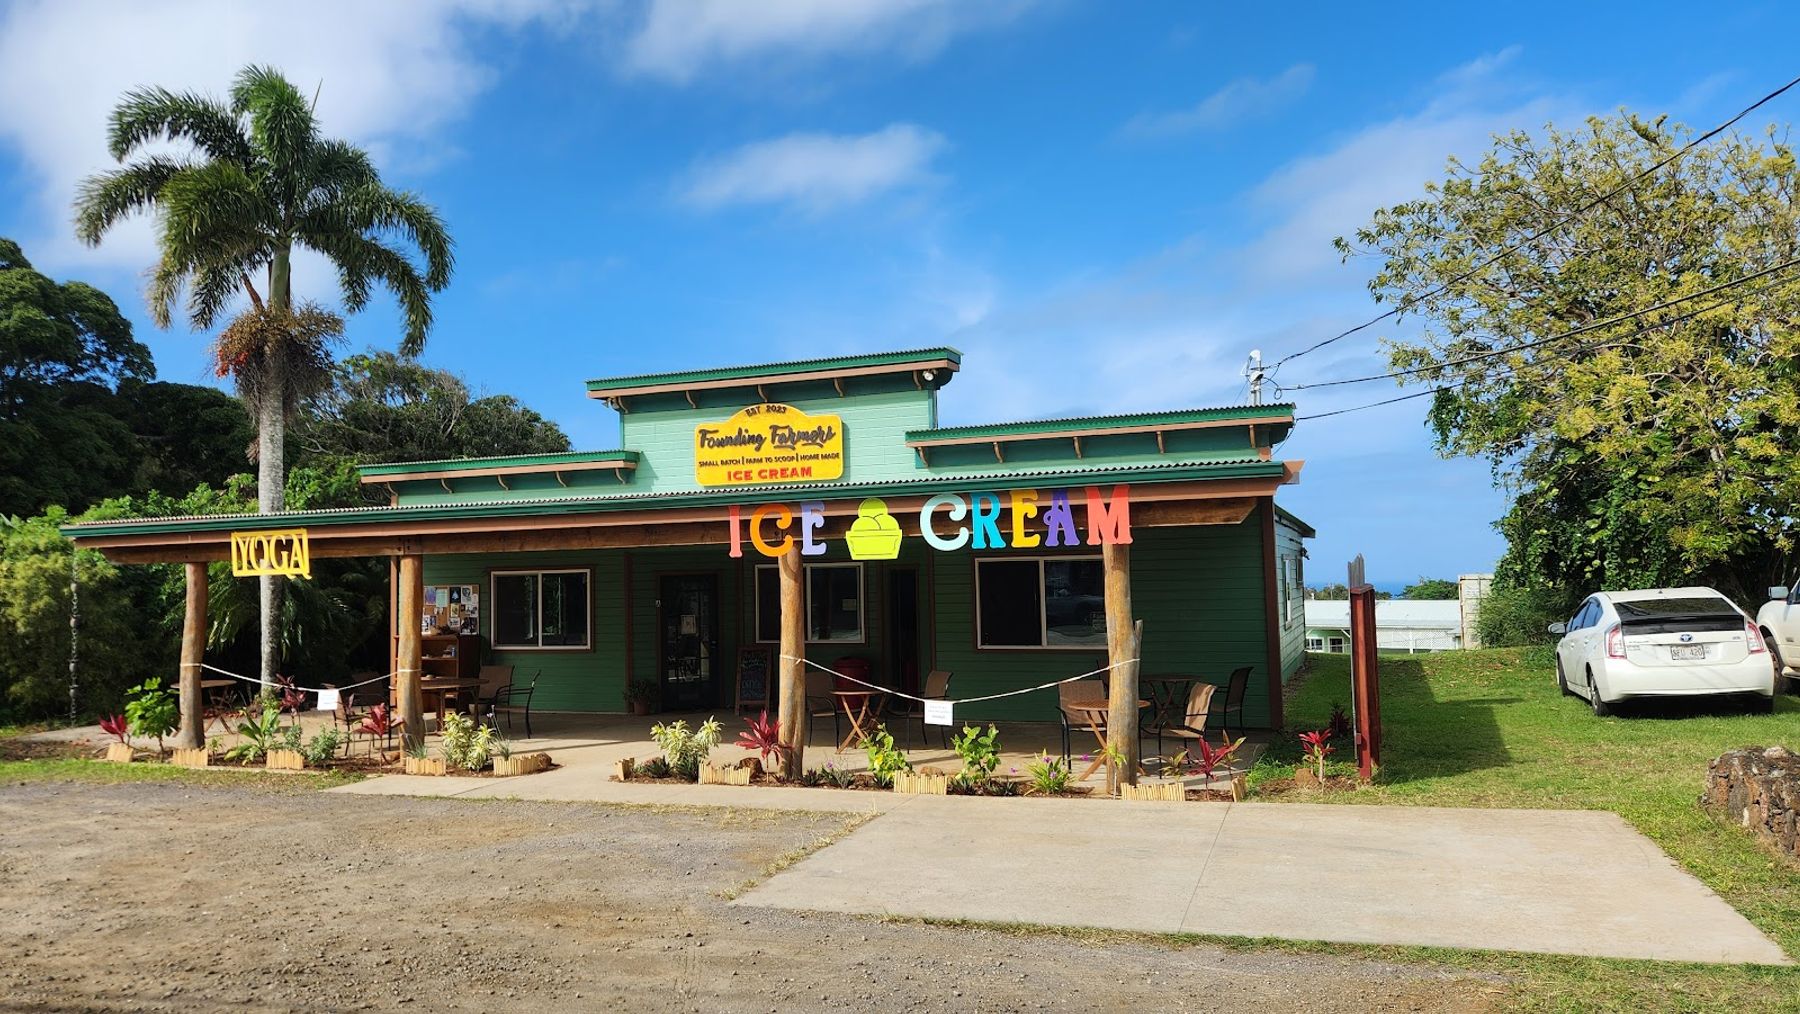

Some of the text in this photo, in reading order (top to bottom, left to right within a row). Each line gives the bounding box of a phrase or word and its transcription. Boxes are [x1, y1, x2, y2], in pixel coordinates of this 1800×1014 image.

[745, 404, 788, 417] EST 2023
[698, 424, 836, 452] Founding Farmers
[698, 460, 719, 468] SMALL
[720, 458, 741, 466] BATCH
[745, 457, 763, 465] FARM
[774, 455, 796, 463] SCOOP
[799, 453, 820, 461] HOME
[821, 452, 840, 460] MADE
[727, 466, 812, 482] ICE CREAM
[728, 484, 1133, 558] ICE CREAM
[235, 532, 310, 578] YOGA
